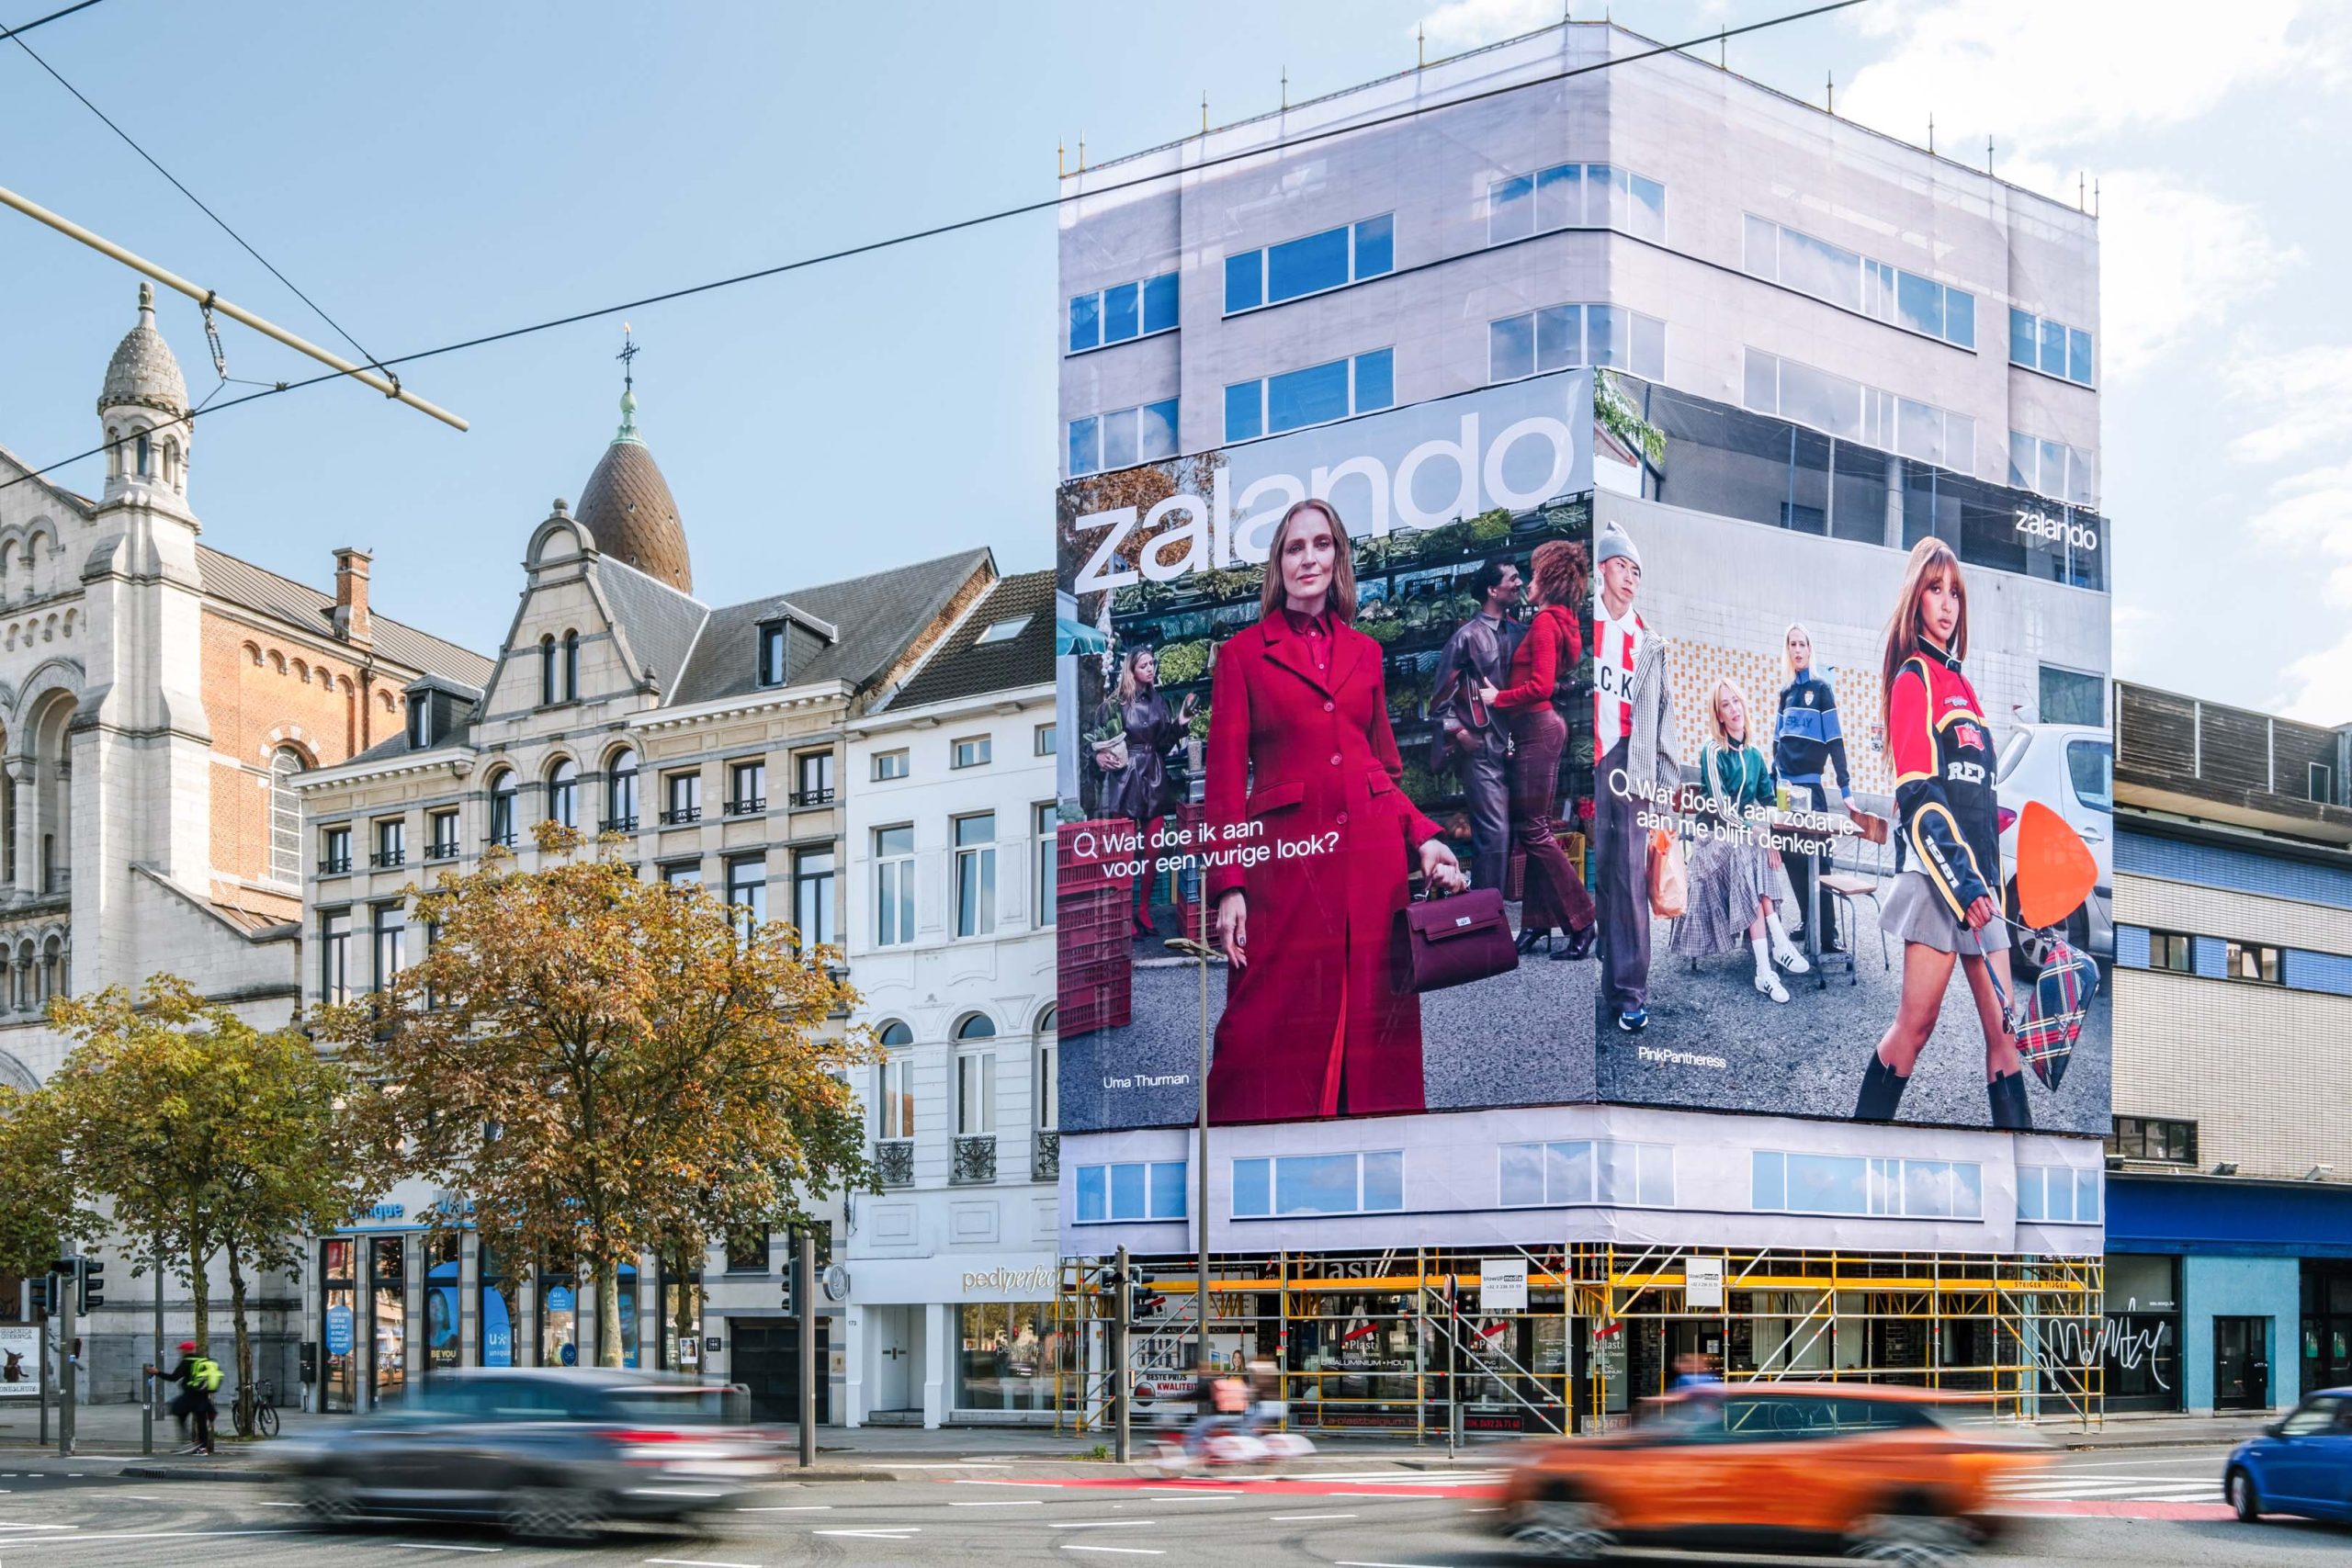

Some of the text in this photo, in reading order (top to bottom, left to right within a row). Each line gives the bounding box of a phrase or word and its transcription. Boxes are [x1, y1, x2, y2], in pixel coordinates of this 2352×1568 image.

[1074, 412, 1575, 594] zalando
[2015, 510, 2098, 551] zalando
[1636, 778, 1854, 838] Wat doe ik aan zodat je
[1102, 819, 1264, 853] Wat doe ik aan
[1636, 810, 1838, 859] aan me blijft denken?
[1102, 831, 1340, 878] voor een vurige look?
[1925, 834, 1961, 889] 1981
[1638, 1045, 1727, 1068] PinkPantheress
[1103, 1074, 1190, 1089] Uma Thurman
[431, 1349, 457, 1358] BE YOU
[1350, 1339, 1375, 1349] Plast
[1157, 1382, 1198, 1391] KWALITEIT
